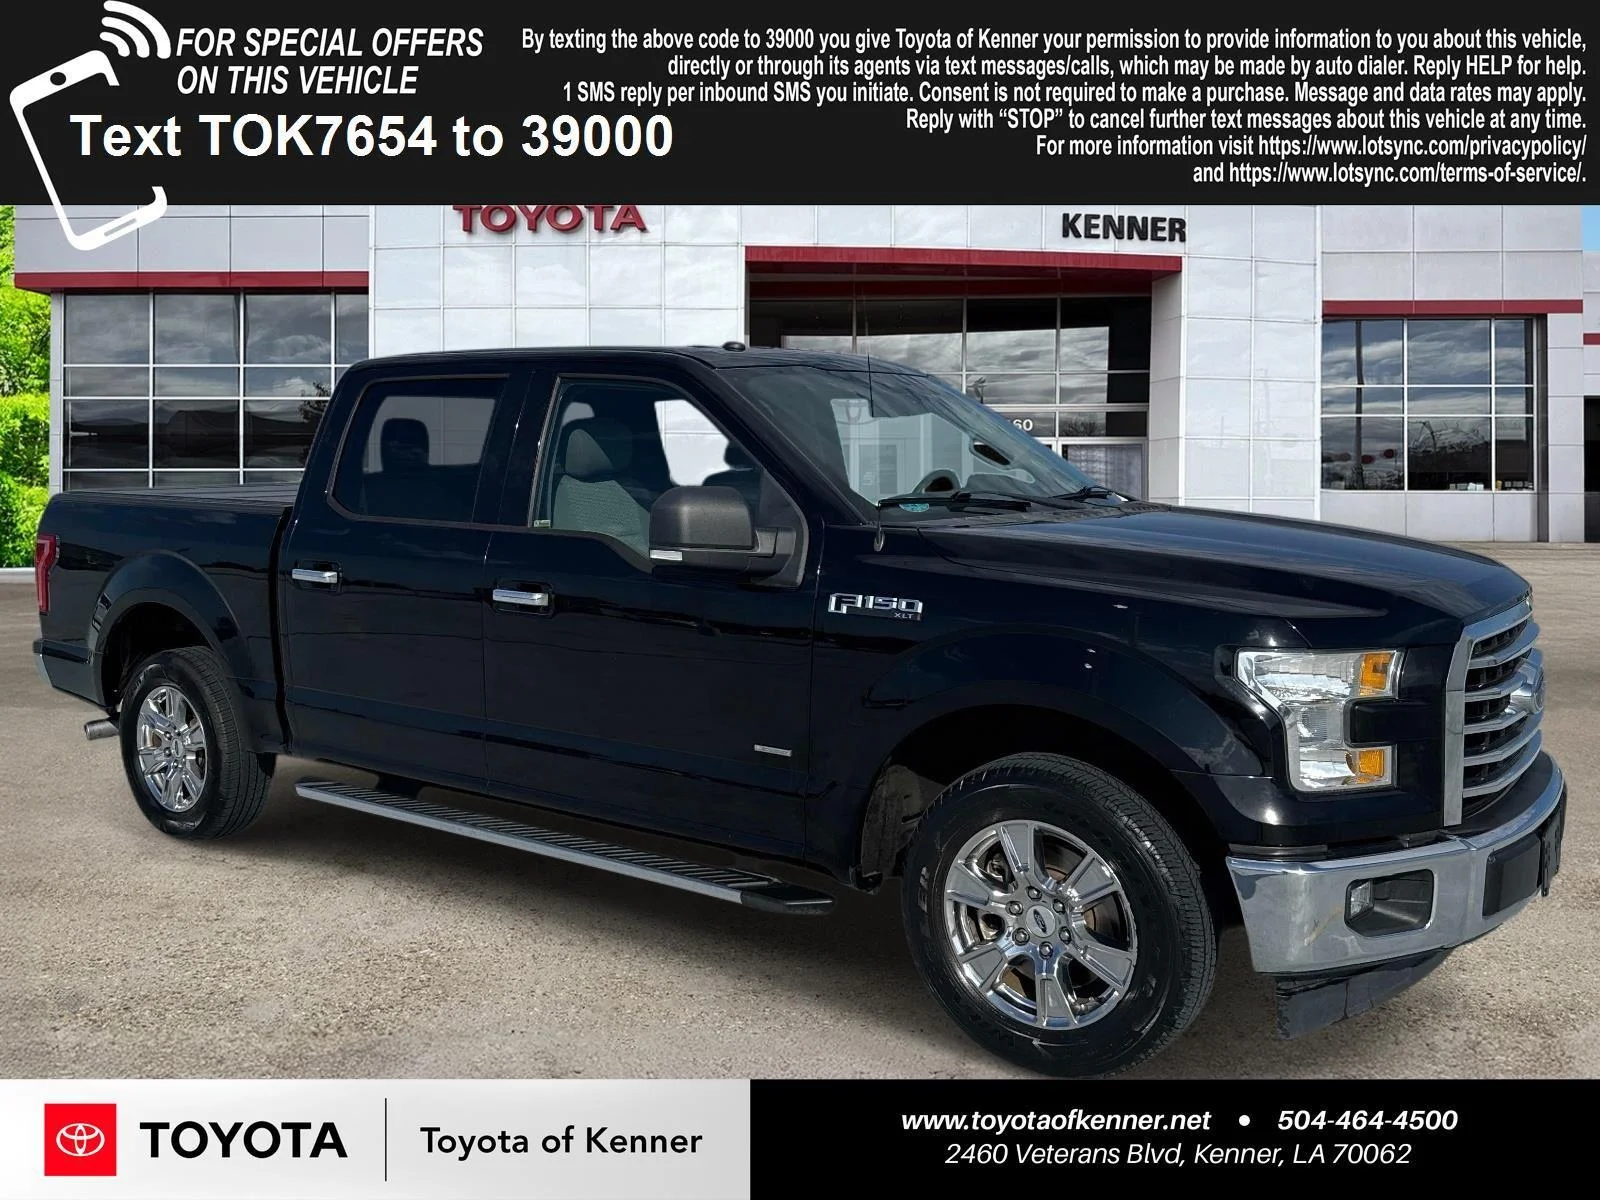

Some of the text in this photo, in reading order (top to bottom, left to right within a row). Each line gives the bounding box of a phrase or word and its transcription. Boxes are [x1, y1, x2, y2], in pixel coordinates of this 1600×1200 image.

[453, 205, 648, 232] TOYOTA
[1062, 213, 1187, 242] KENNER
[893, 612, 915, 620] XLT
